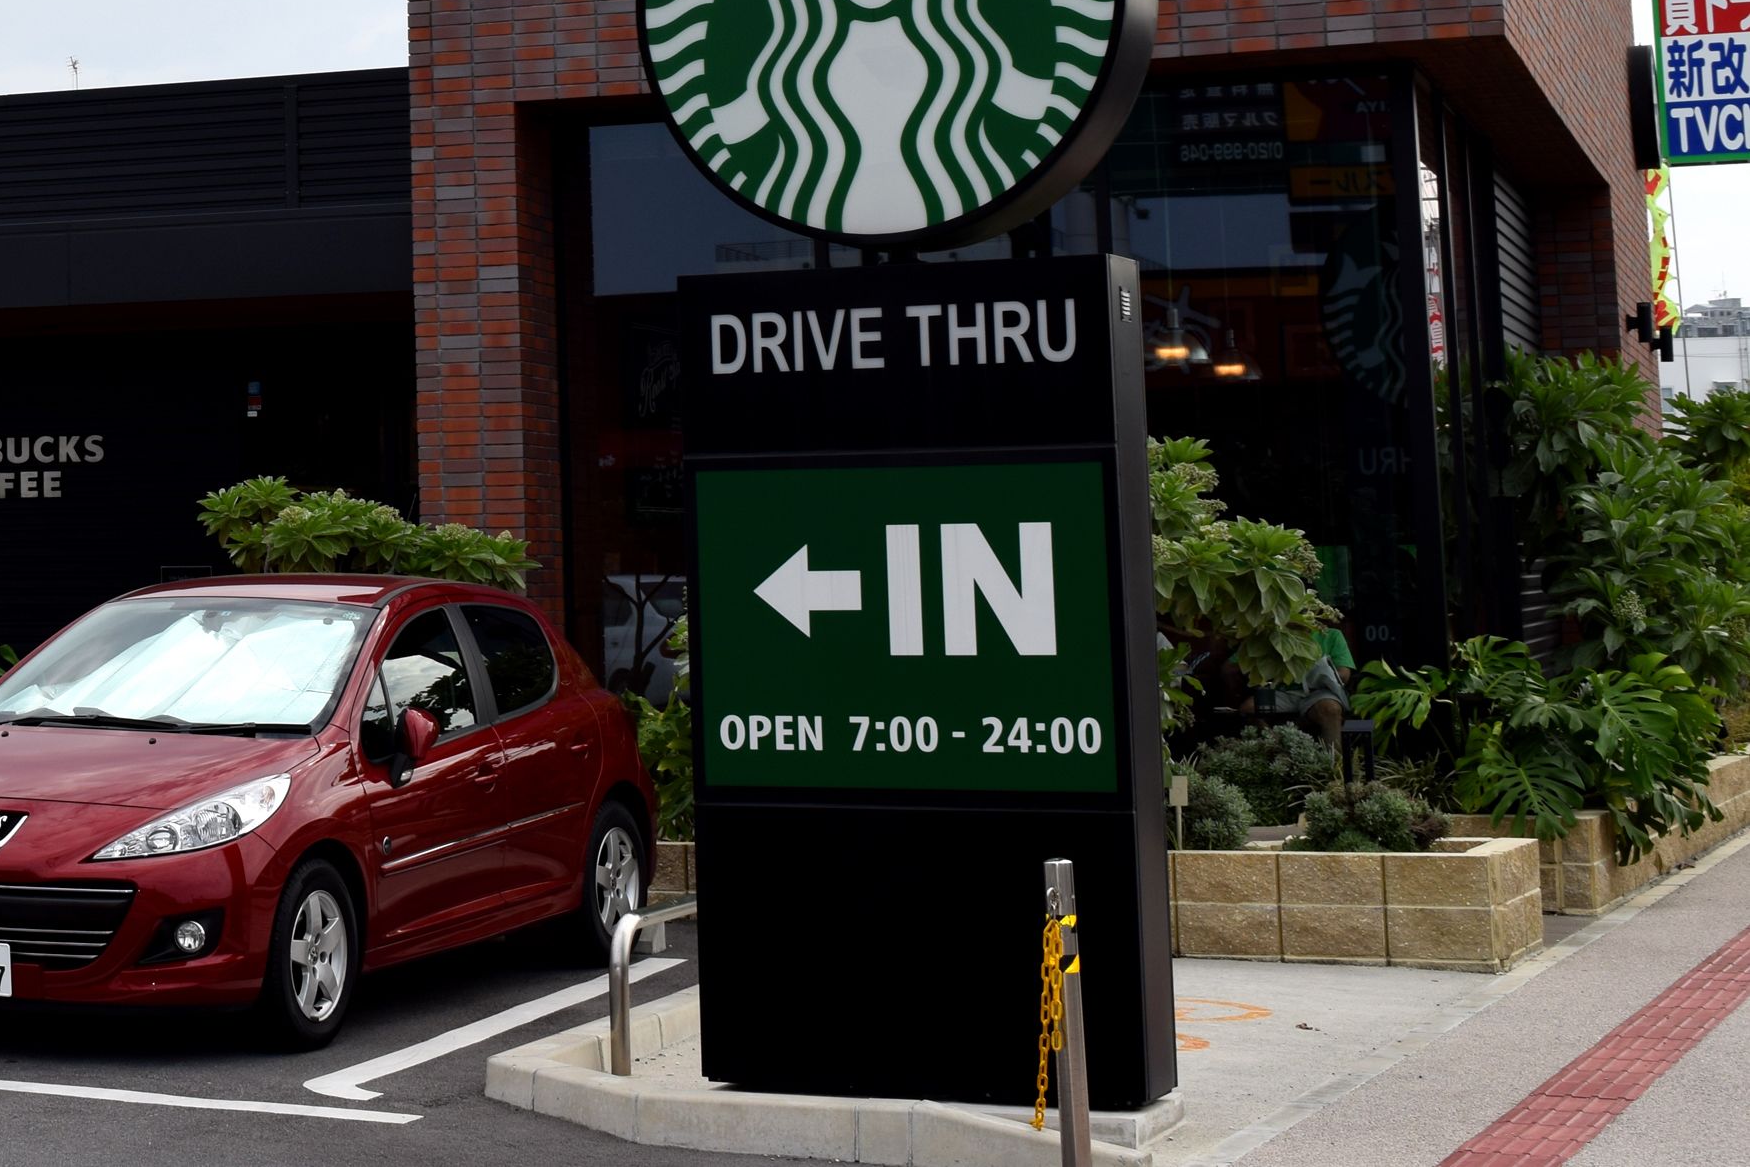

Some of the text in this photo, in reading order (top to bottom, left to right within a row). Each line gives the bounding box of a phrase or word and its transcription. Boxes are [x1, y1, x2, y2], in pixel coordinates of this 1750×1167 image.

[1670, 103, 1750, 153] TVC
[711, 309, 885, 375] DRIVE
[906, 298, 1077, 367] THRU
[886, 521, 1057, 656] IN
[720, 715, 823, 751] OPEN
[849, 716, 939, 752] 7:00
[981, 716, 1102, 754] 24:00
